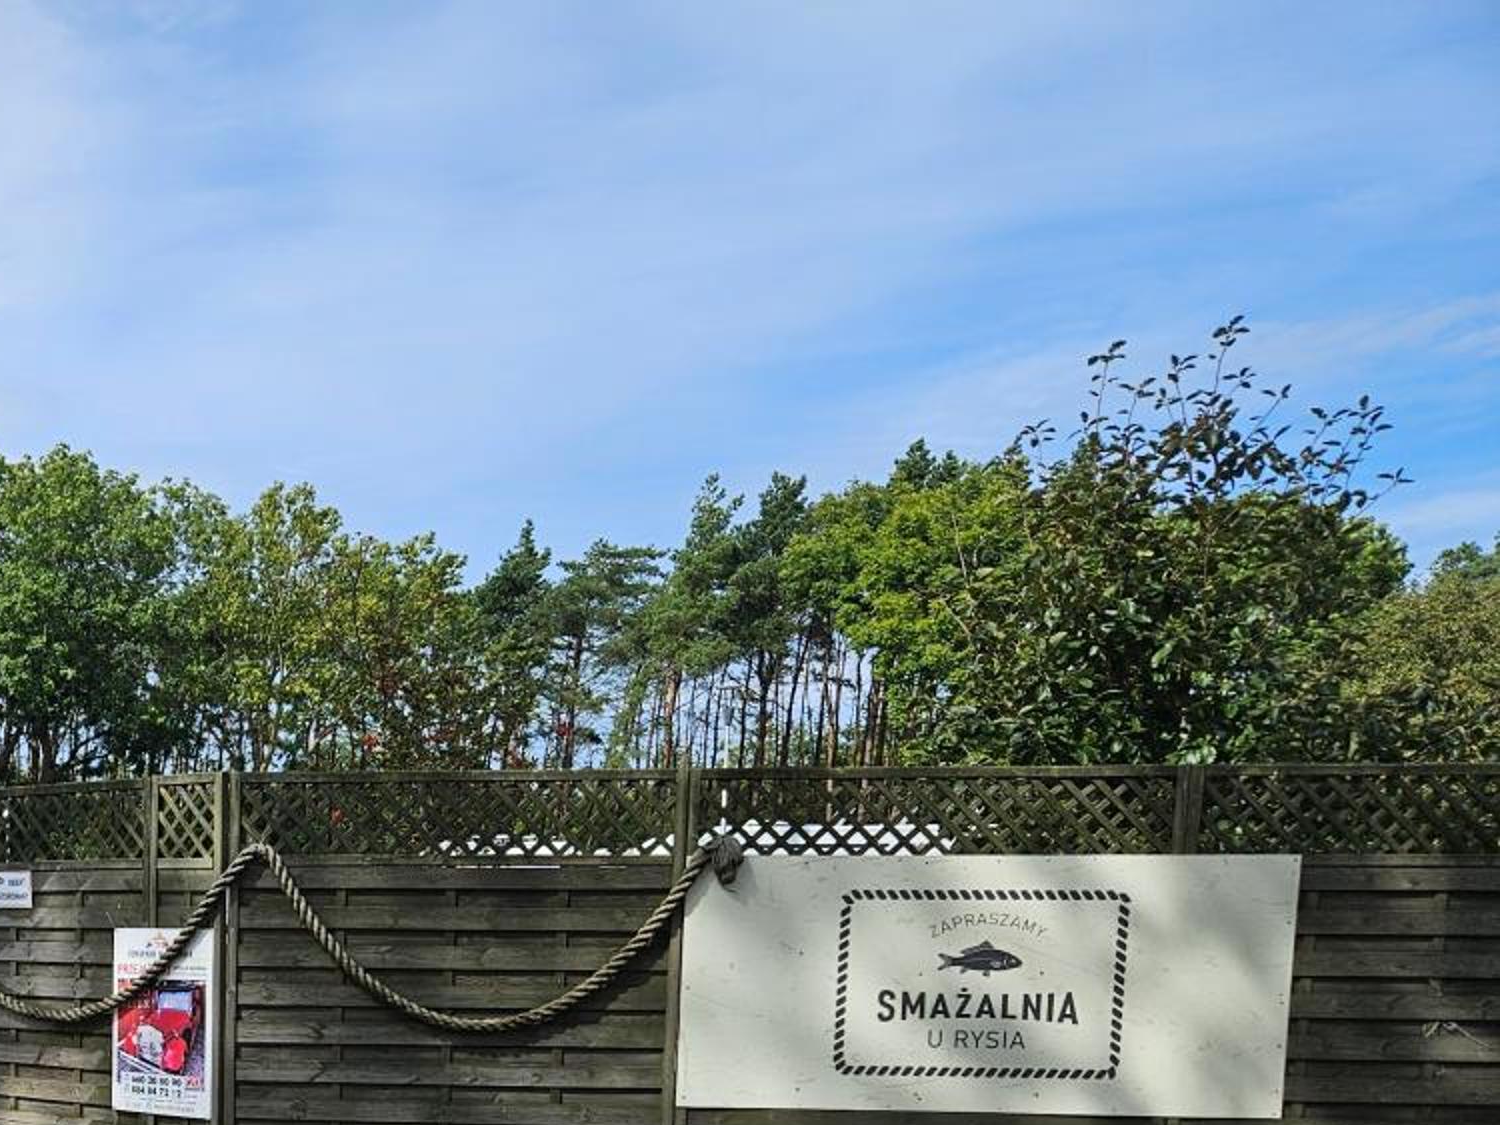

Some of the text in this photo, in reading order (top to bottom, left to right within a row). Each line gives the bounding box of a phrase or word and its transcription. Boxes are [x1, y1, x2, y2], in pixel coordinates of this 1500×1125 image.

[929, 913, 1049, 939] ZAPRASZAMY
[877, 987, 1079, 1025] SMAŻALNIA
[927, 1029, 1026, 1050] U RYSIA
